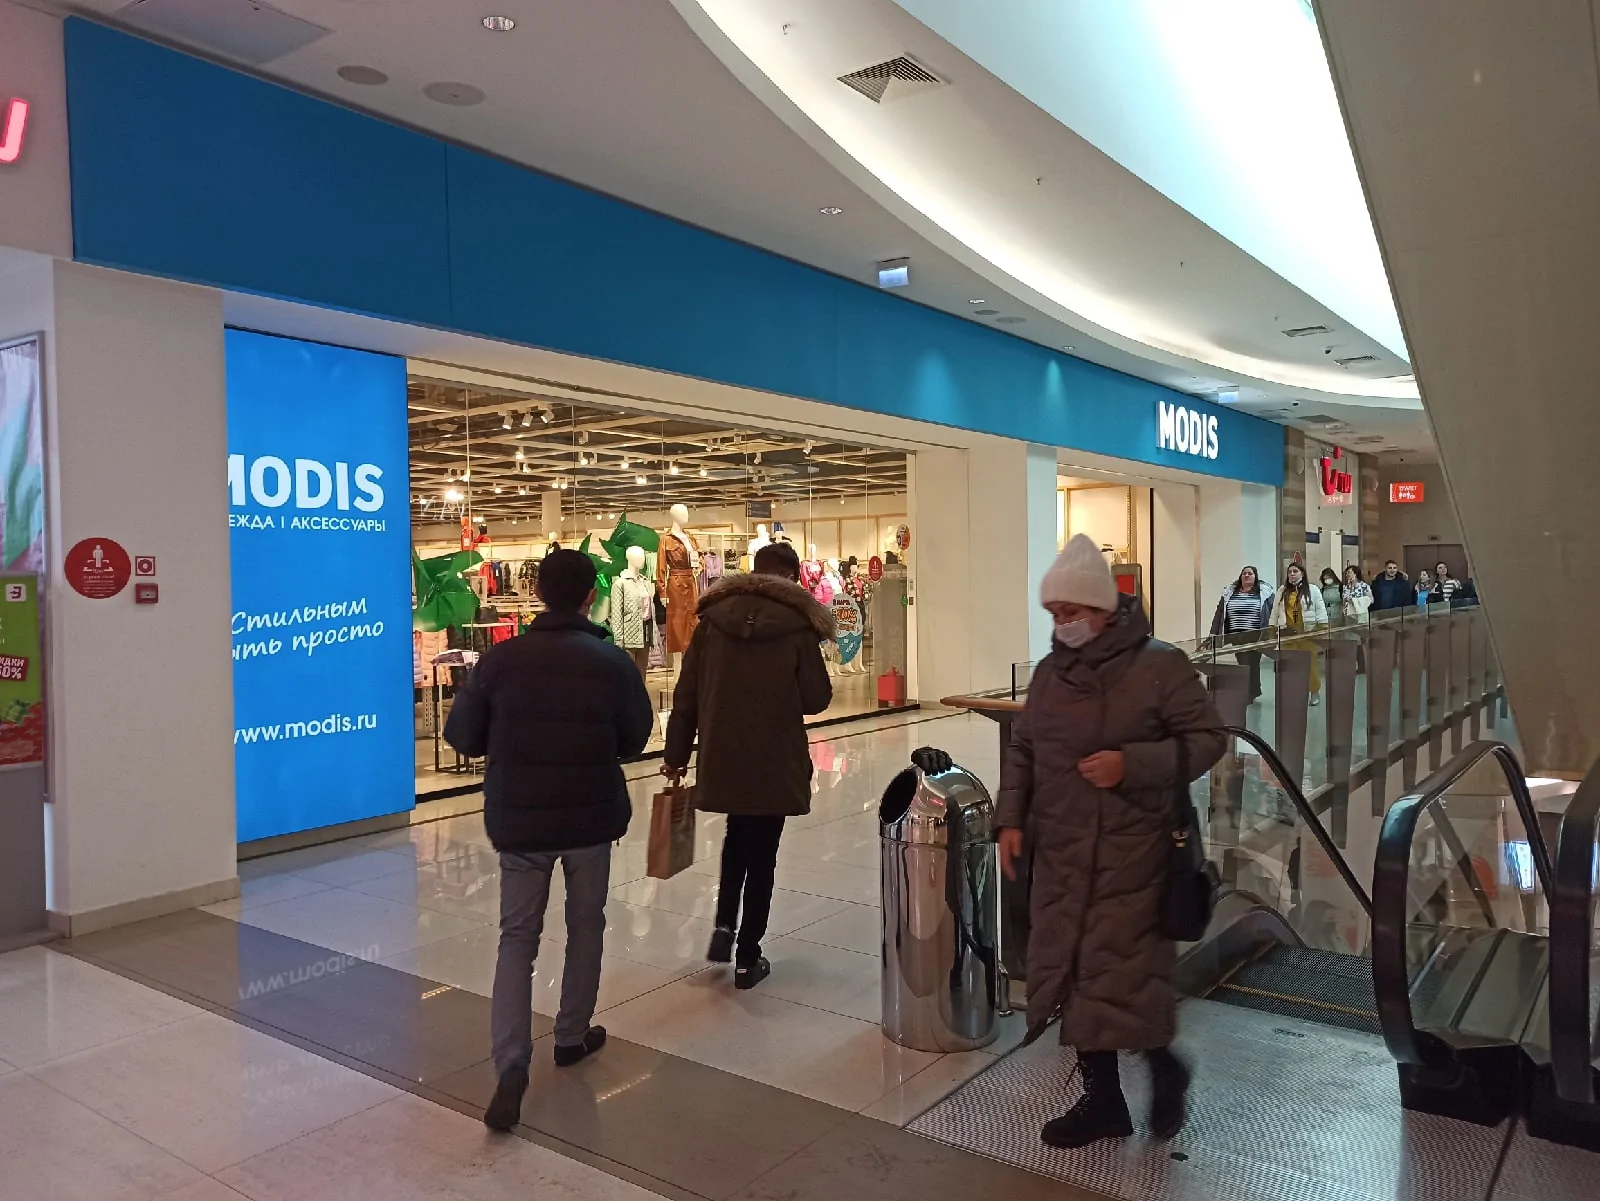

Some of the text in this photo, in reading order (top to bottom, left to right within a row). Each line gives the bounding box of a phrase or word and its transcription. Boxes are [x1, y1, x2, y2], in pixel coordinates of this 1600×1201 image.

[1156, 400, 1219, 460] MODIS
[290, 516, 386, 532] АКСЕССУАРЫ
[231, 597, 367, 635] Стильным
[292, 620, 384, 656] просто
[0, 666, 22, 679] 0%
[233, 713, 377, 745] ww.modis.ru
